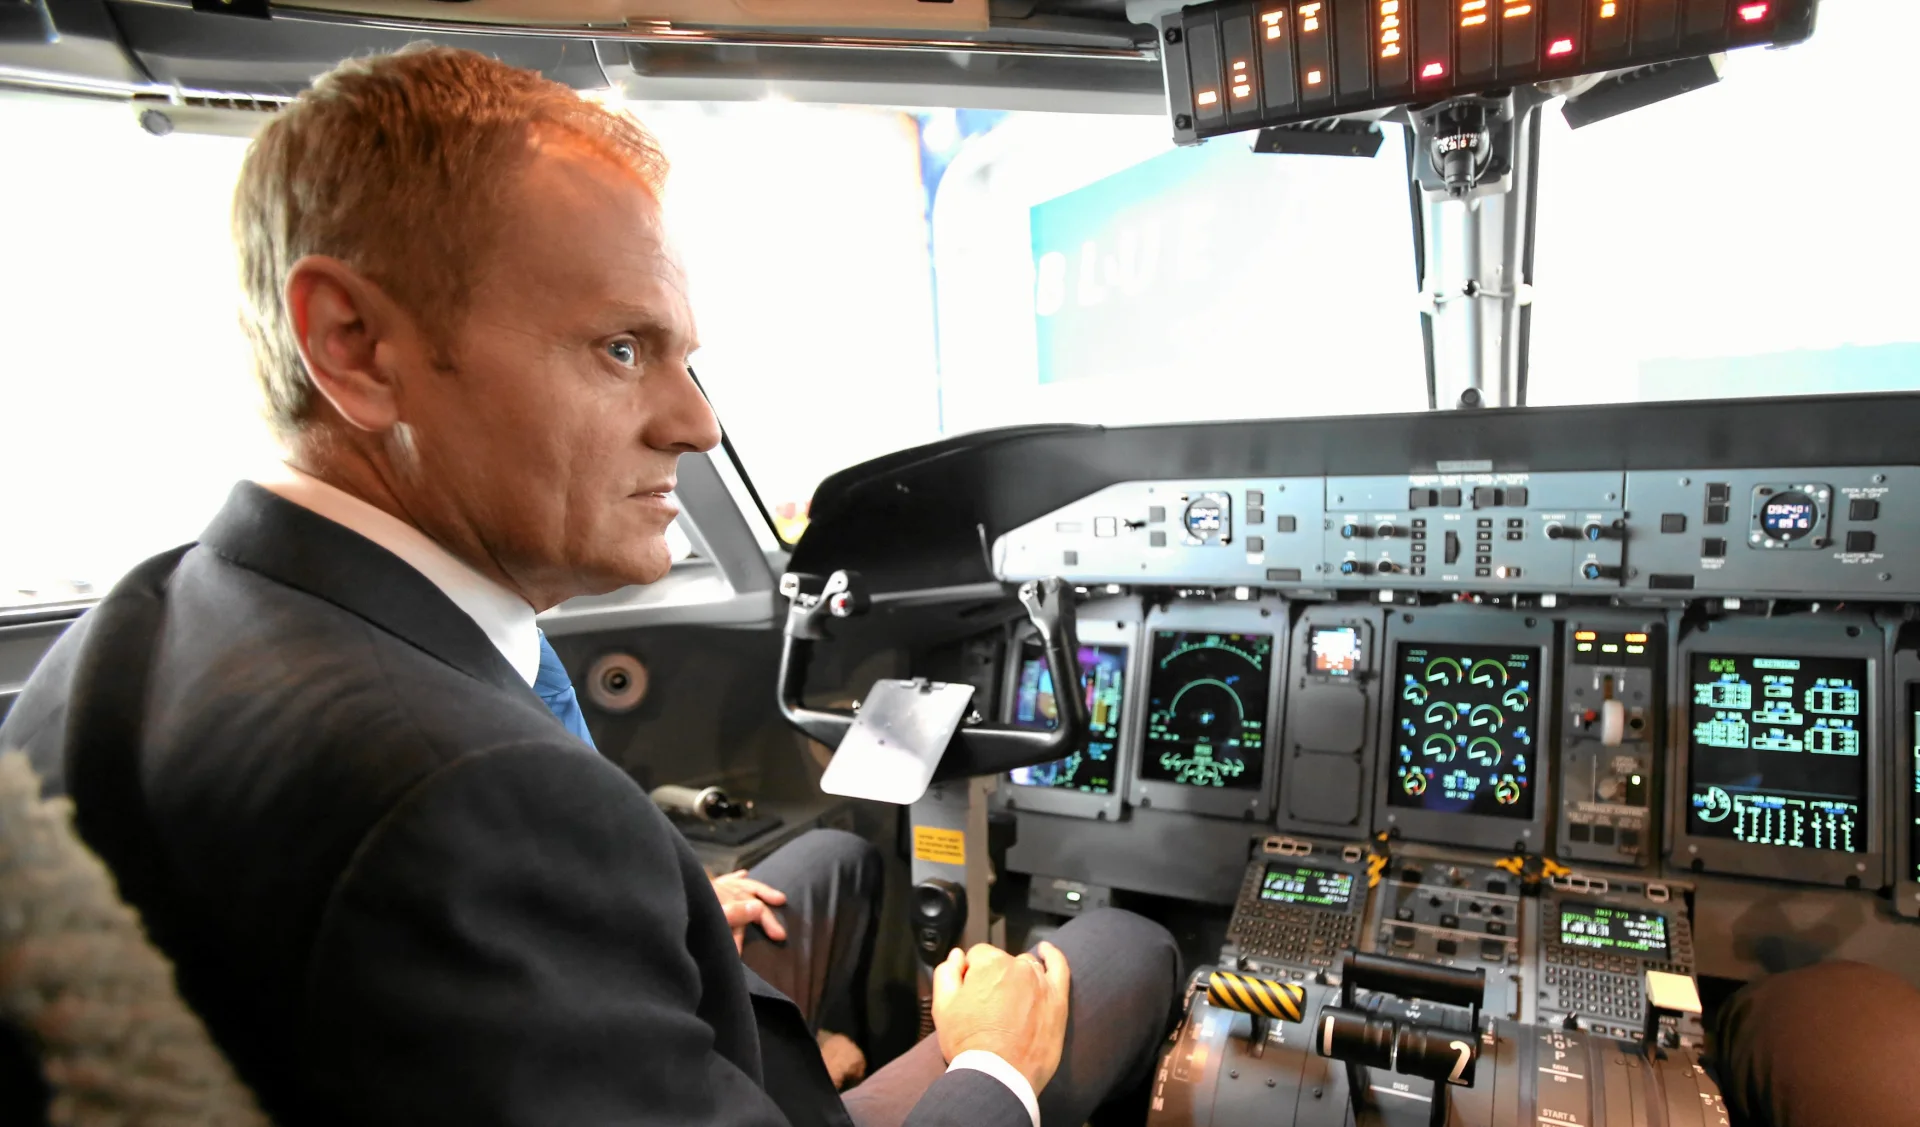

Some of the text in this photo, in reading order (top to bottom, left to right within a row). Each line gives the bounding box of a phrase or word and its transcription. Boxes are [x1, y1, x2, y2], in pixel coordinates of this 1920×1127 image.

[1035, 198, 1217, 317] BLUE
[1448, 1040, 1471, 1085] 2
[1542, 1108, 1568, 1121] START
